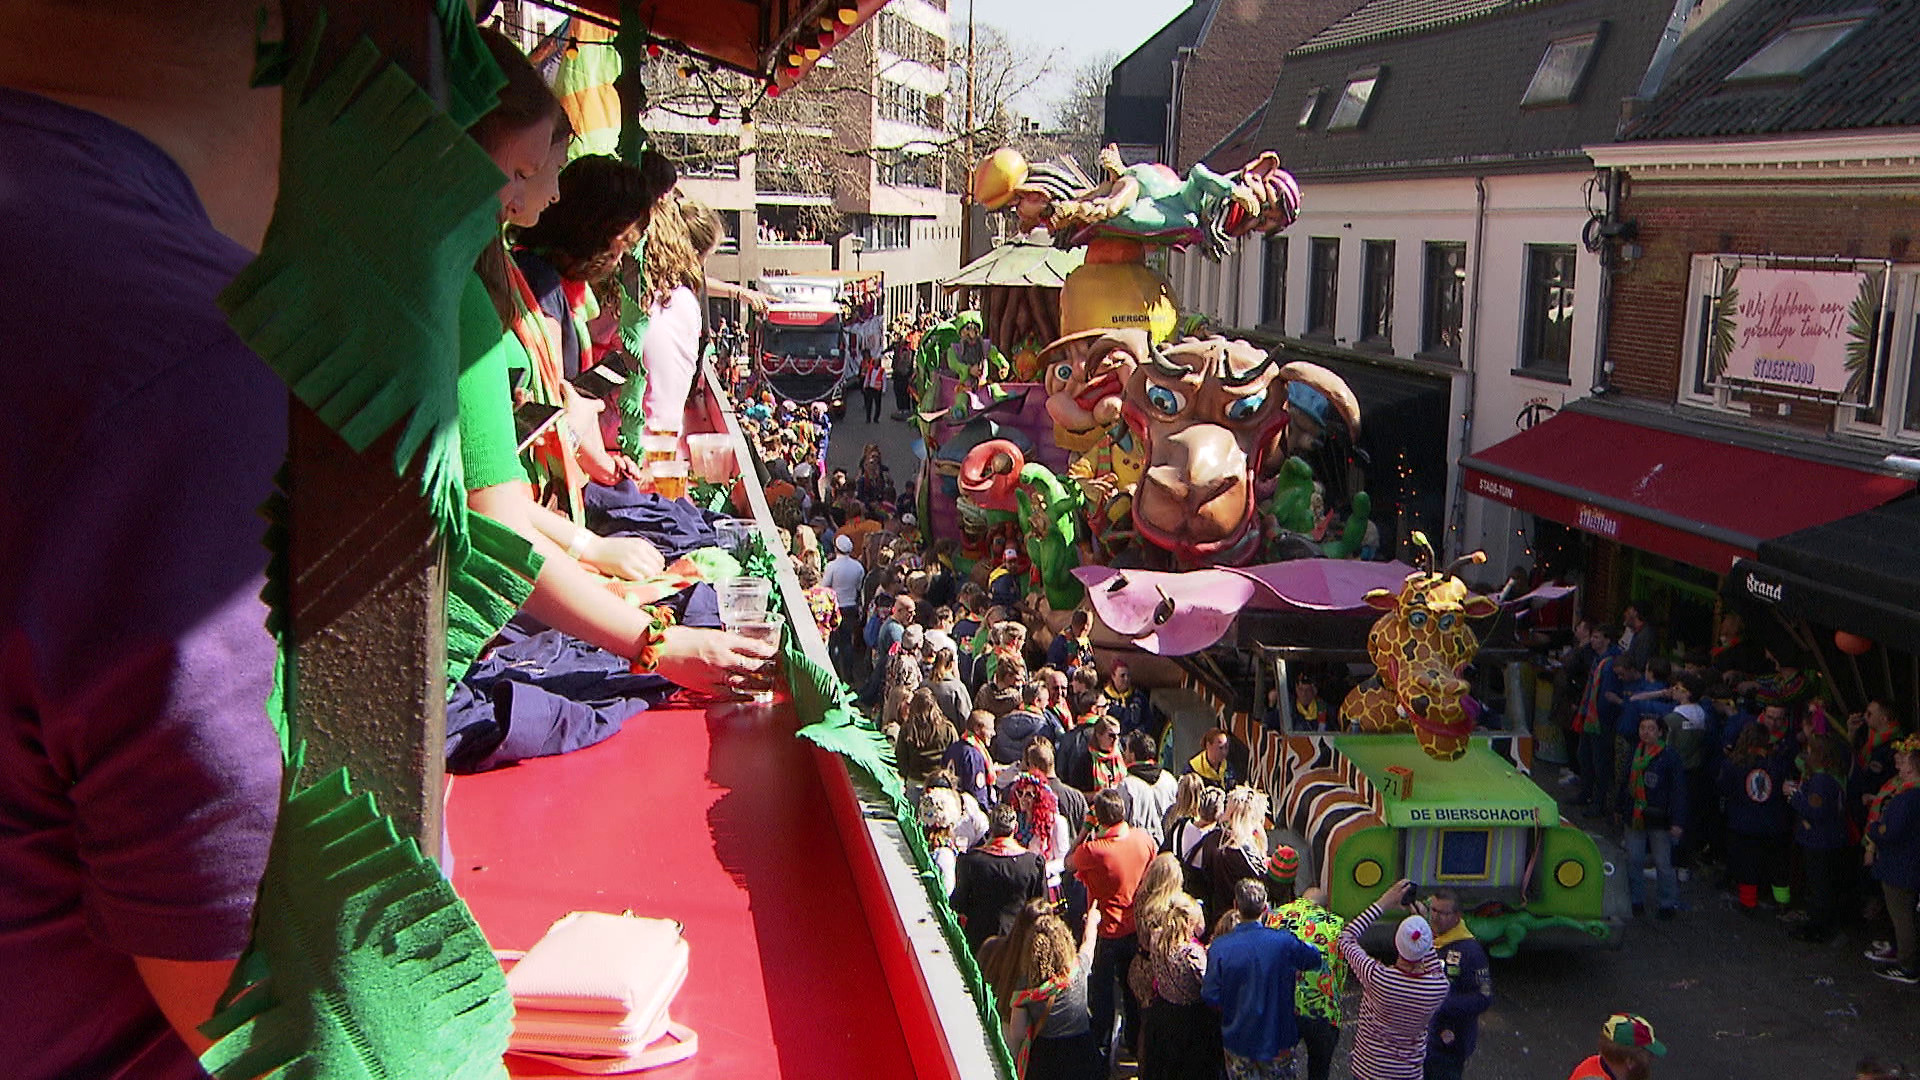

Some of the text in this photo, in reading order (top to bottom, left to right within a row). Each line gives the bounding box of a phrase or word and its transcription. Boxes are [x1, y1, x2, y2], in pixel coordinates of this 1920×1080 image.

[1769, 292, 1815, 316] hebben
[1820, 303, 1845, 314] een
[1111, 314, 1165, 324] BIERSCH
[1741, 317, 1795, 349] gezellige
[1753, 357, 1815, 384] STREETFOOD
[1746, 572, 1782, 601] Brand
[1383, 777, 1398, 796] 71
[1411, 809, 1431, 821] DE
